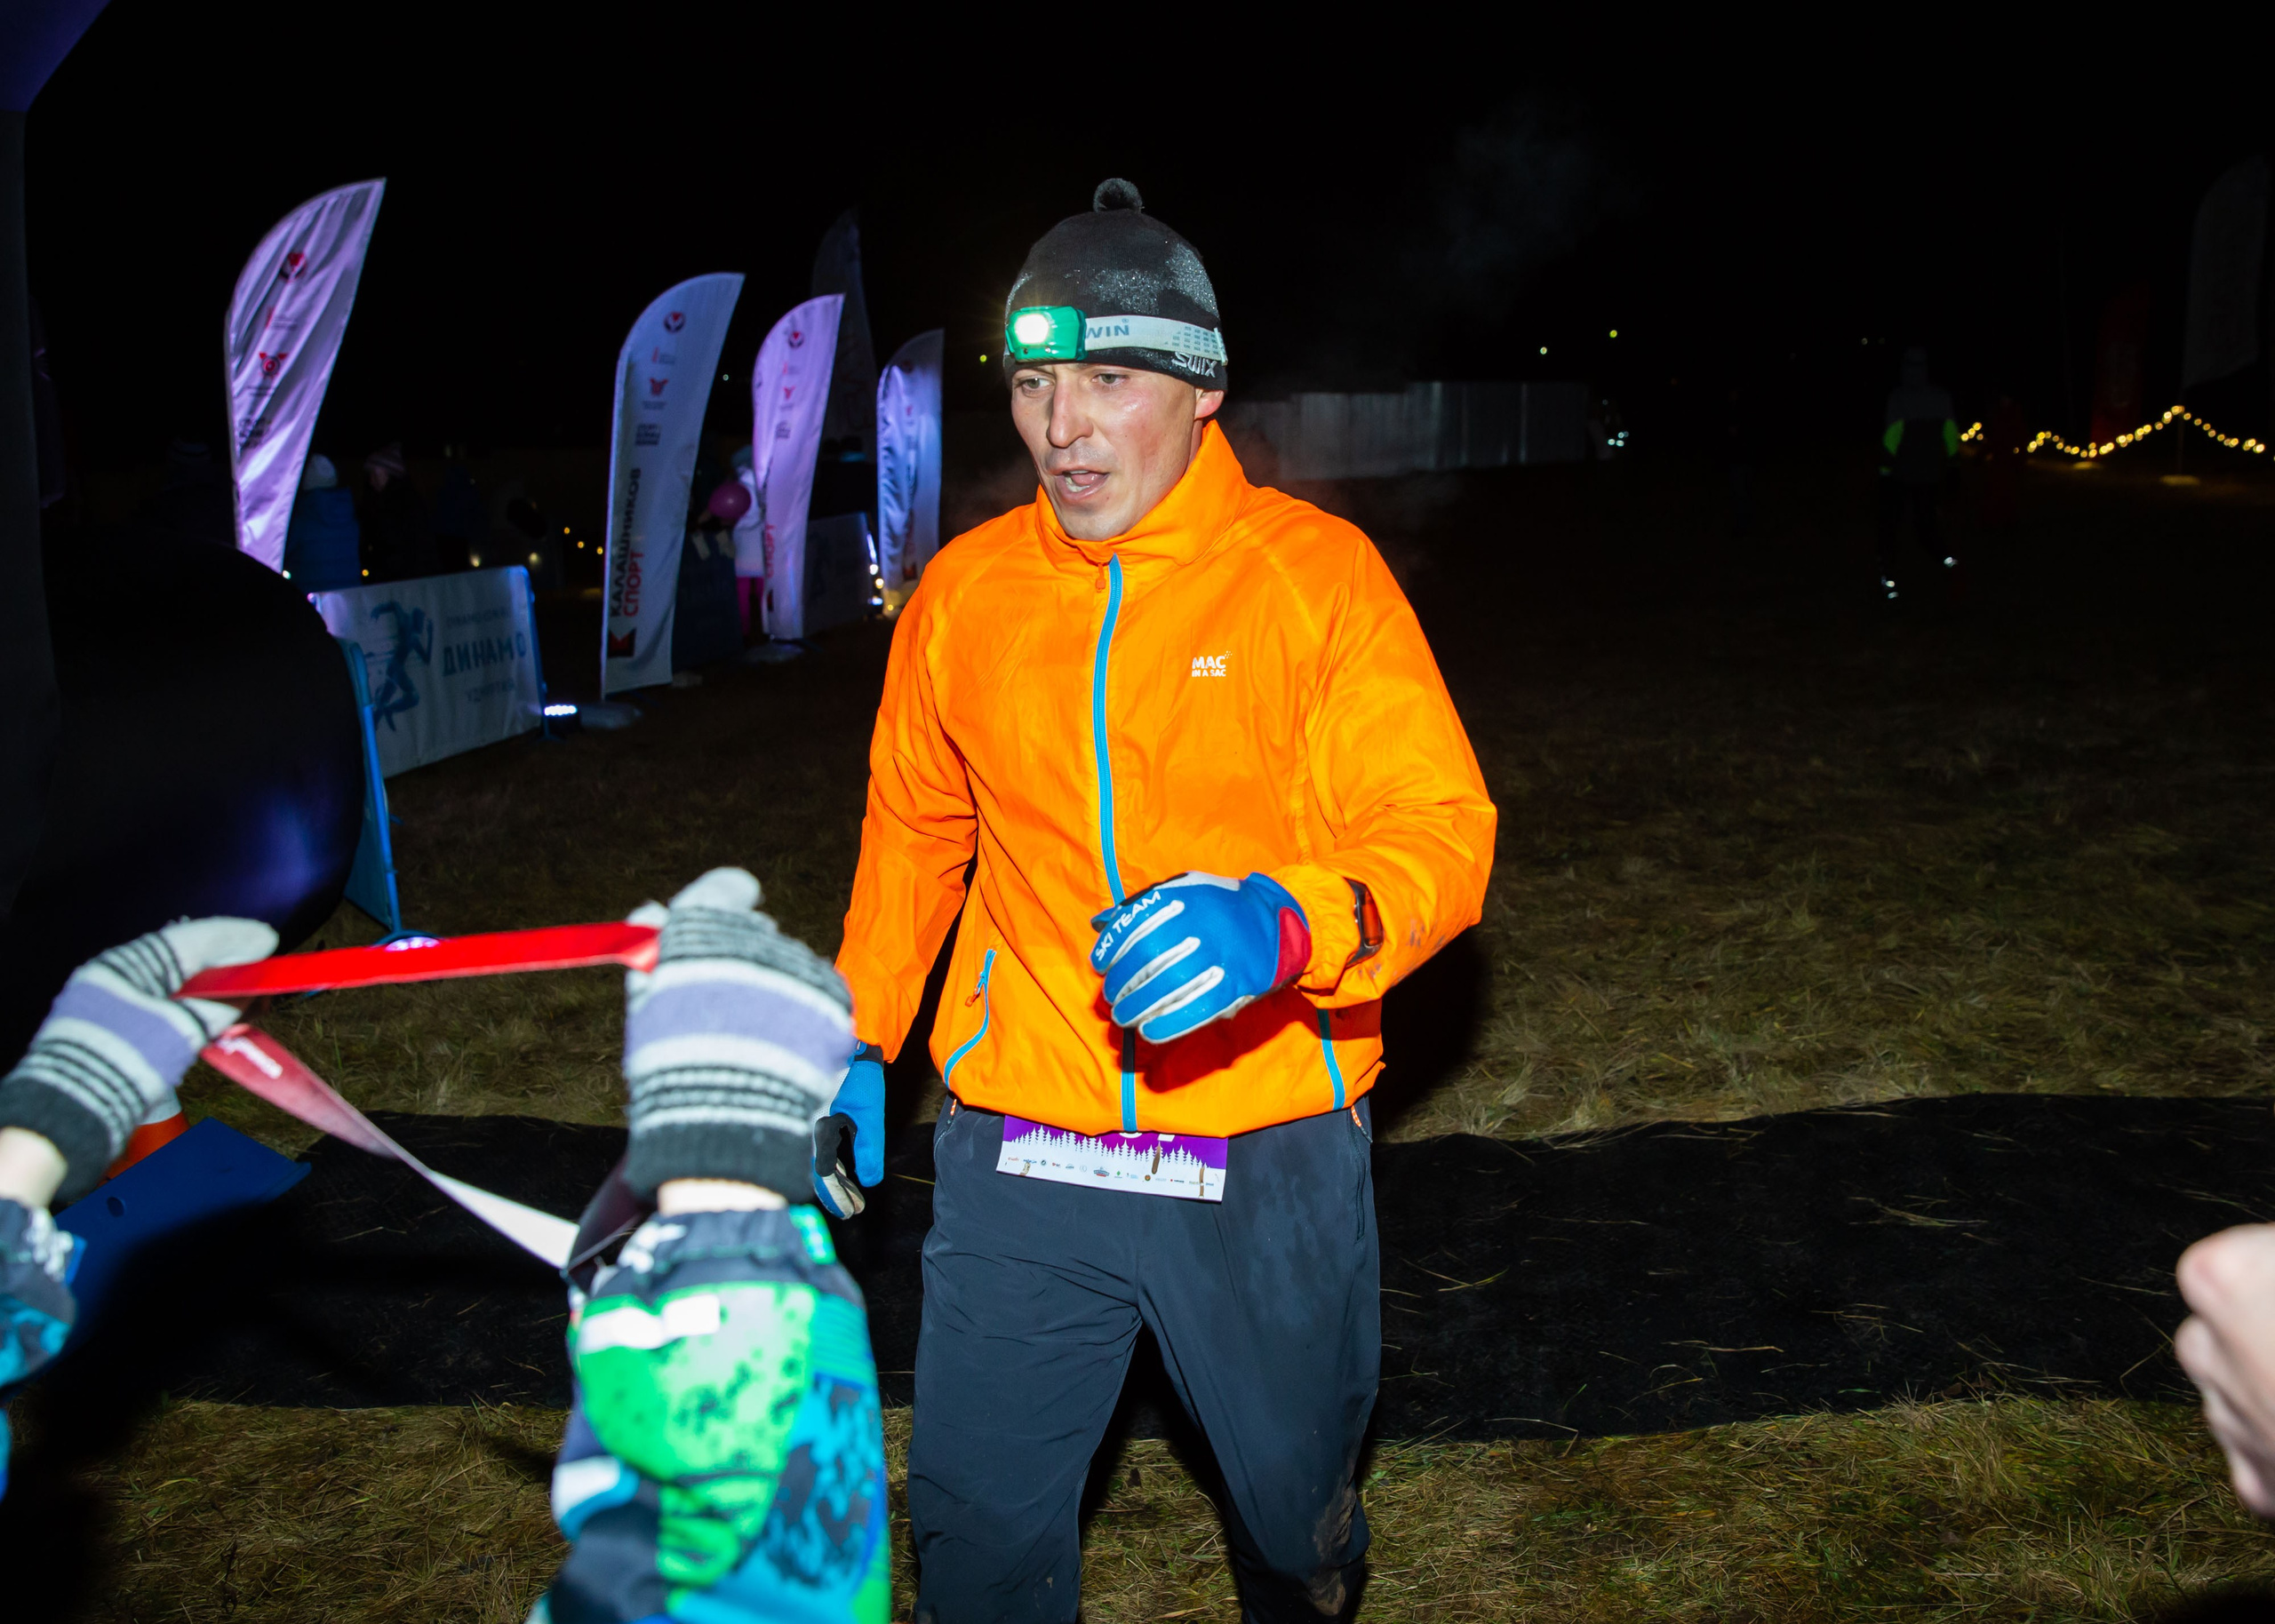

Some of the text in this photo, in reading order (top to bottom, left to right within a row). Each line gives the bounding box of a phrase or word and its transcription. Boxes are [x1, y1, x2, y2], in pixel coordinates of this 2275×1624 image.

[611, 467, 642, 617] КАЛАШНИКОВ
[624, 549, 644, 617] СПОРТ
[443, 631, 526, 676] ДИНАМО
[1192, 656, 1226, 669] MAC
[1095, 891, 1161, 961] SKI TEAM
